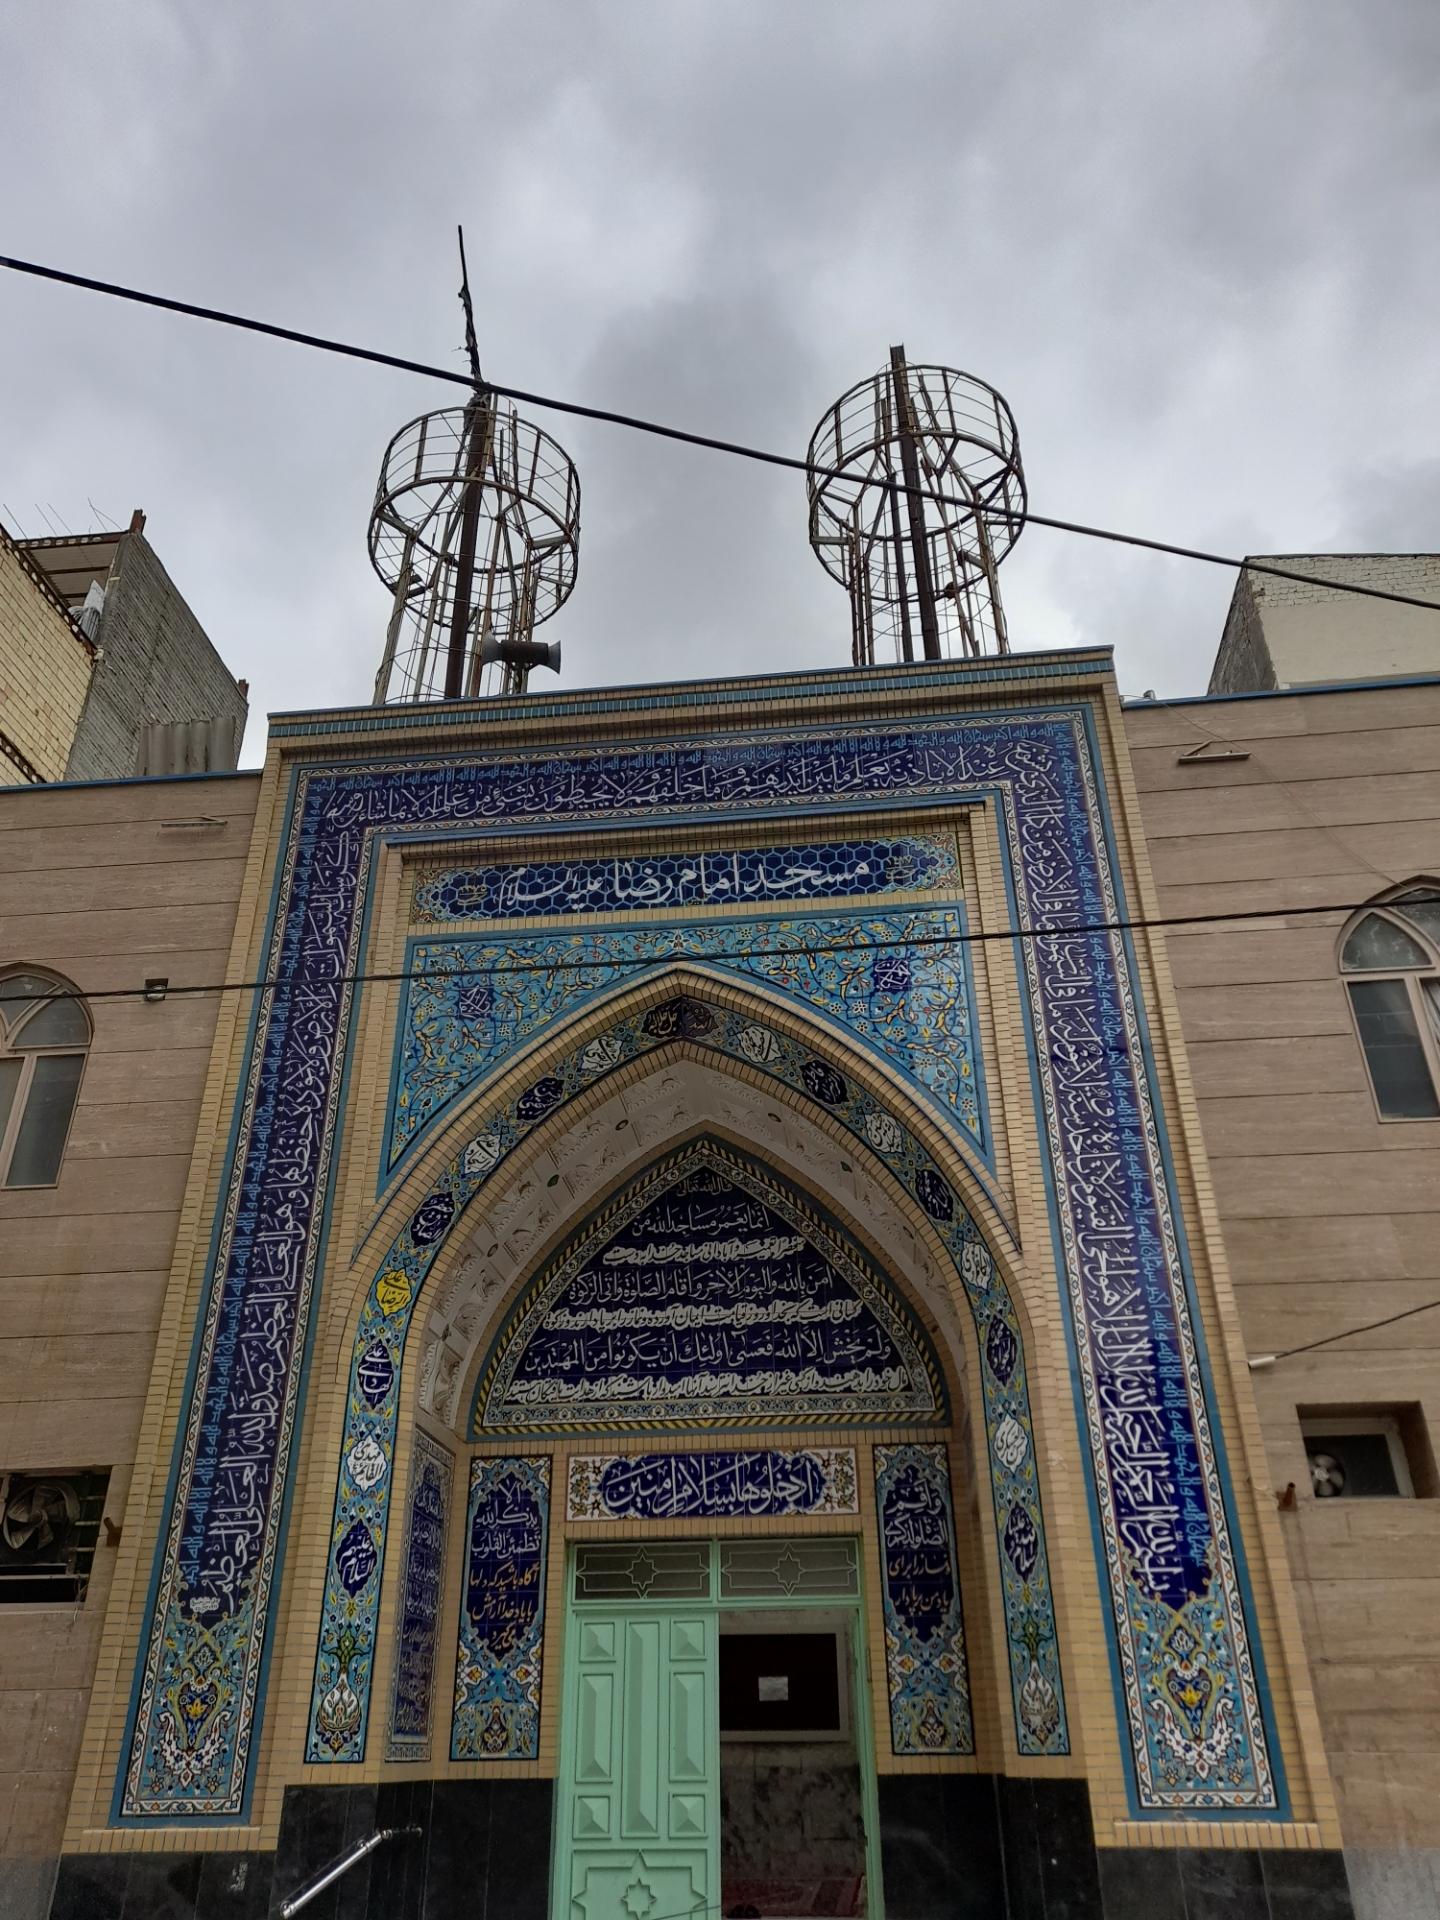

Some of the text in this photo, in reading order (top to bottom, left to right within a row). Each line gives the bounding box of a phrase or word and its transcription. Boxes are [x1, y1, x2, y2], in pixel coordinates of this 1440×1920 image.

[496, 852, 870, 914] مسجد امام رضا علیه السلام
[632, 1214, 651, 1237] من
[647, 1205, 671, 1234] الله
[670, 1203, 717, 1238] مساجد
[775, 1332, 802, 1359] الله
[735, 1453, 819, 1515] ادخلوها
[475, 1499, 539, 1529] بذکر الله
[471, 1531, 507, 1559] القلوب
